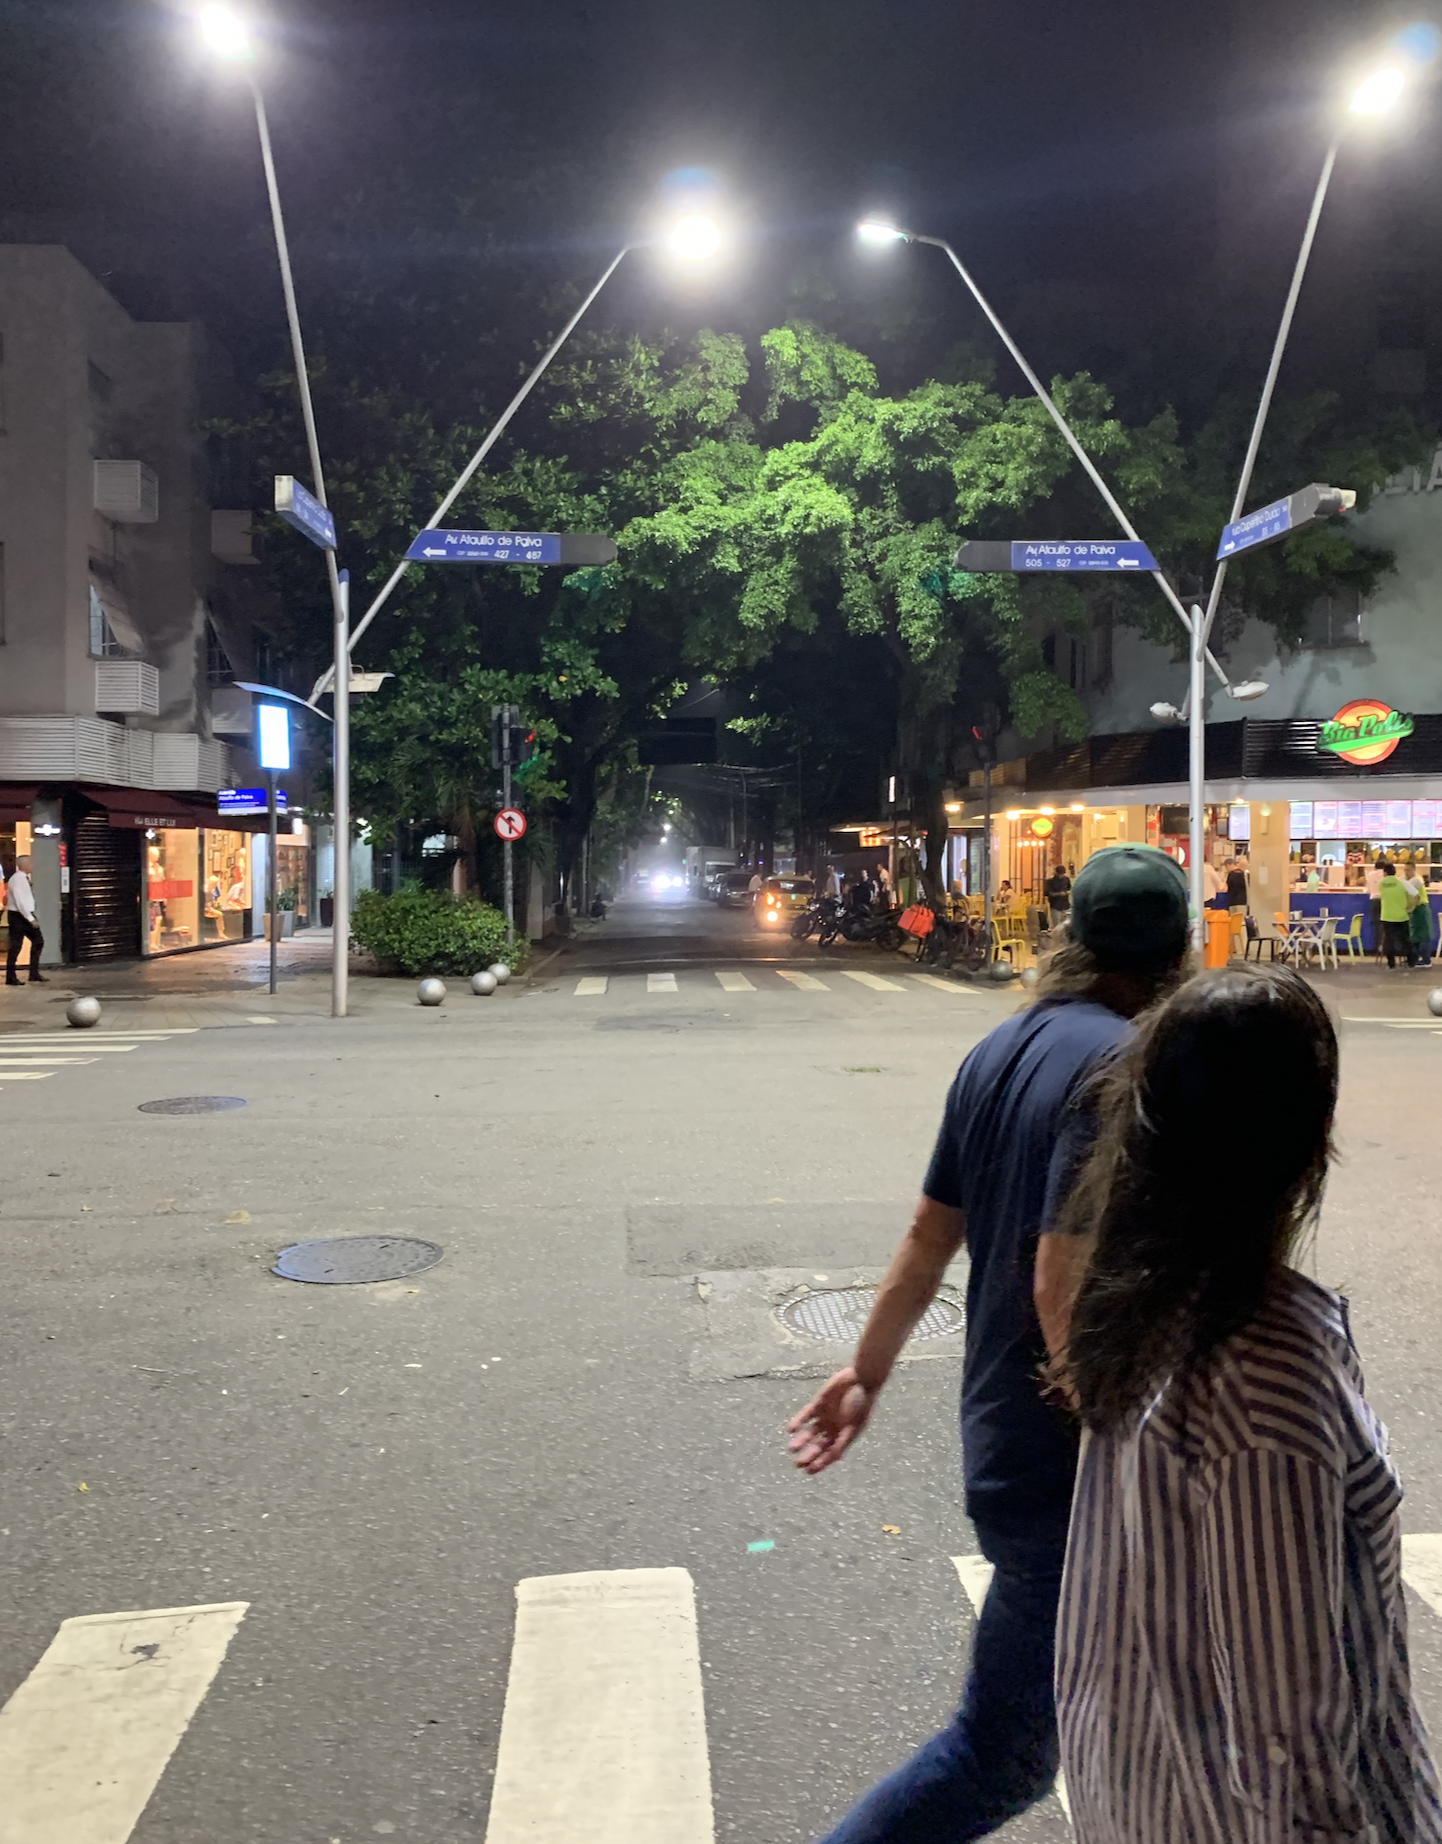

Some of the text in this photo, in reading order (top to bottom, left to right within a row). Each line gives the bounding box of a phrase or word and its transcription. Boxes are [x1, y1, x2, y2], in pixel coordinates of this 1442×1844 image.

[459, 534, 494, 546] Ataulfo
[497, 536, 513, 546] de
[515, 536, 542, 548] Paiva
[494, 550, 510, 559] 427
[1038, 544, 1071, 555] Ataulfo
[1074, 544, 1088, 555] de
[1090, 544, 1116, 555] Paiva
[1025, 558, 1042, 568] 505
[1056, 558, 1072, 568] 527
